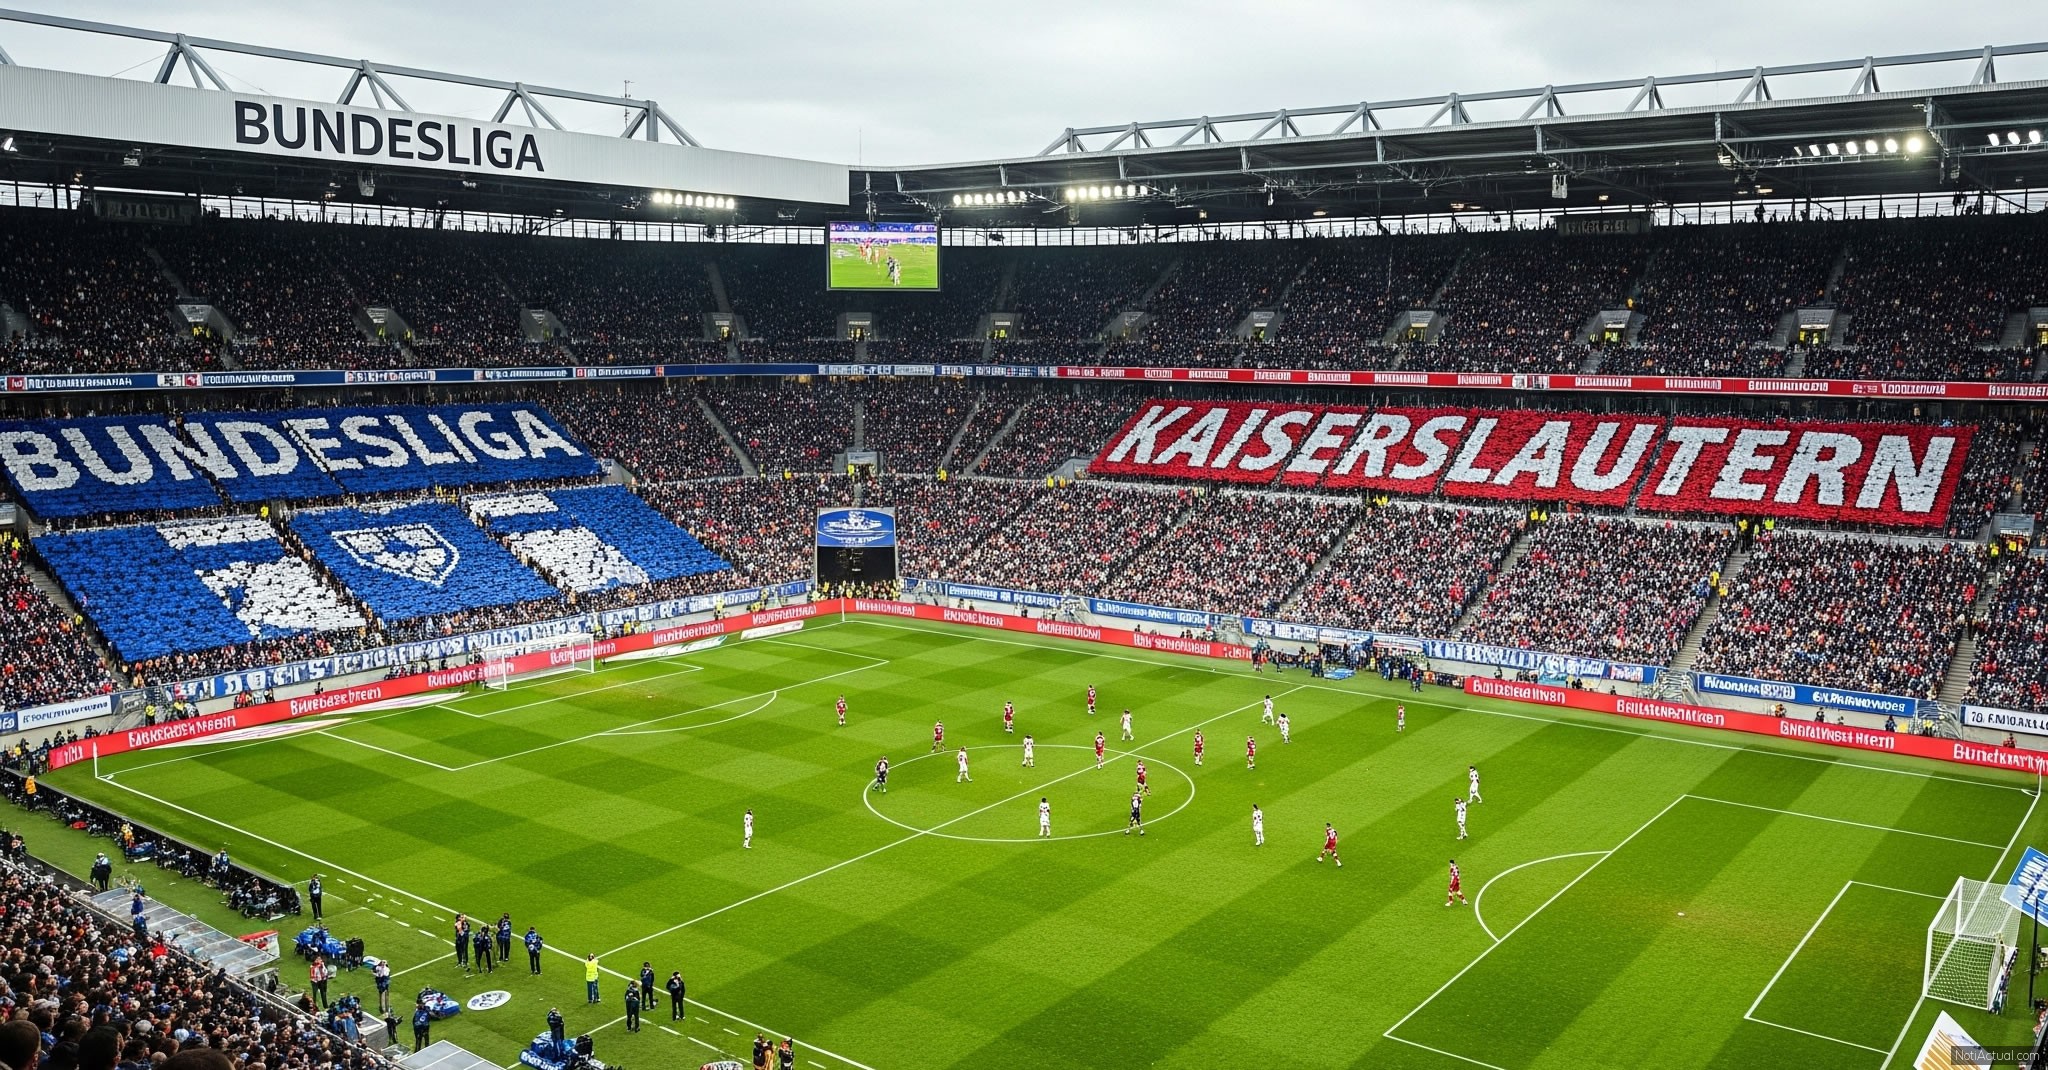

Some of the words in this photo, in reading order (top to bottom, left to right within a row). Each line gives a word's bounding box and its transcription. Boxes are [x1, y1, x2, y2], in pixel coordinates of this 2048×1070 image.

[235, 100, 545, 172] BUNDESLIGA
[0, 409, 583, 492] BUNDESLIGA
[1106, 405, 1956, 513] KAISERSLAUTERN
